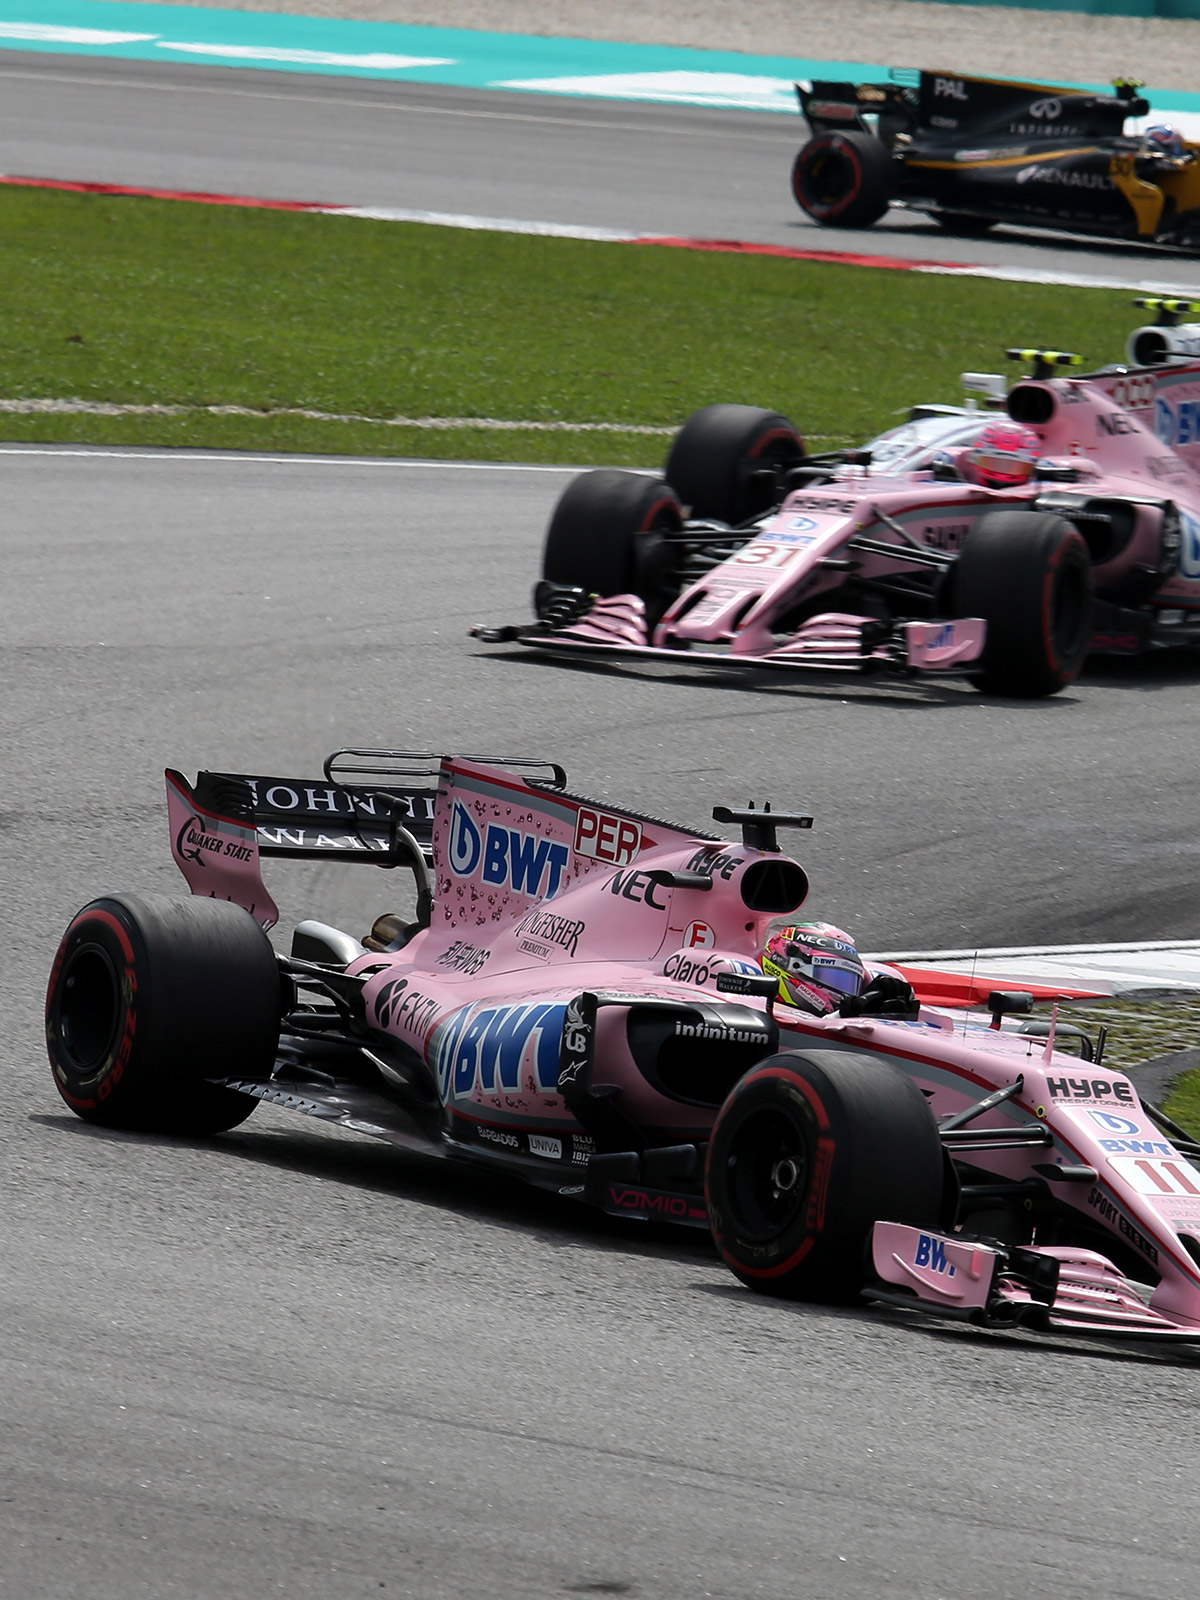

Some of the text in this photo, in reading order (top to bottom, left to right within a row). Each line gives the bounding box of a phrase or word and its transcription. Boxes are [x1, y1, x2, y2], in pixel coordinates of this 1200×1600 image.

[934, 78, 968, 99] PAL
[1033, 166, 1118, 191] RENAULT
[734, 545, 805, 566] 31
[243, 779, 435, 820] JOHNI
[186, 828, 255, 863] QUAKER STATE
[576, 809, 641, 865] PER
[480, 821, 572, 902] BWT
[686, 851, 745, 881] HYPE
[601, 868, 667, 911] NEC
[513, 910, 586, 958] KINGFISHER
[689, 923, 708, 948] F
[796, 933, 827, 947] NEC
[520, 938, 551, 958] PREMIUM
[663, 953, 709, 986] Claro
[396, 991, 446, 1041] FXTM
[675, 1021, 769, 1045] infinitum
[453, 1000, 569, 1100] BWT
[1046, 1077, 1134, 1102] HYPE
[476, 1125, 520, 1148] BARBADOS
[530, 1136, 561, 1155] UNIVA
[571, 1134, 596, 1145] BLU
[1098, 1139, 1175, 1157] BWT
[571, 1151, 591, 1163] IBIZ
[1087, 1186, 1158, 1265] SPORT BIBLE
